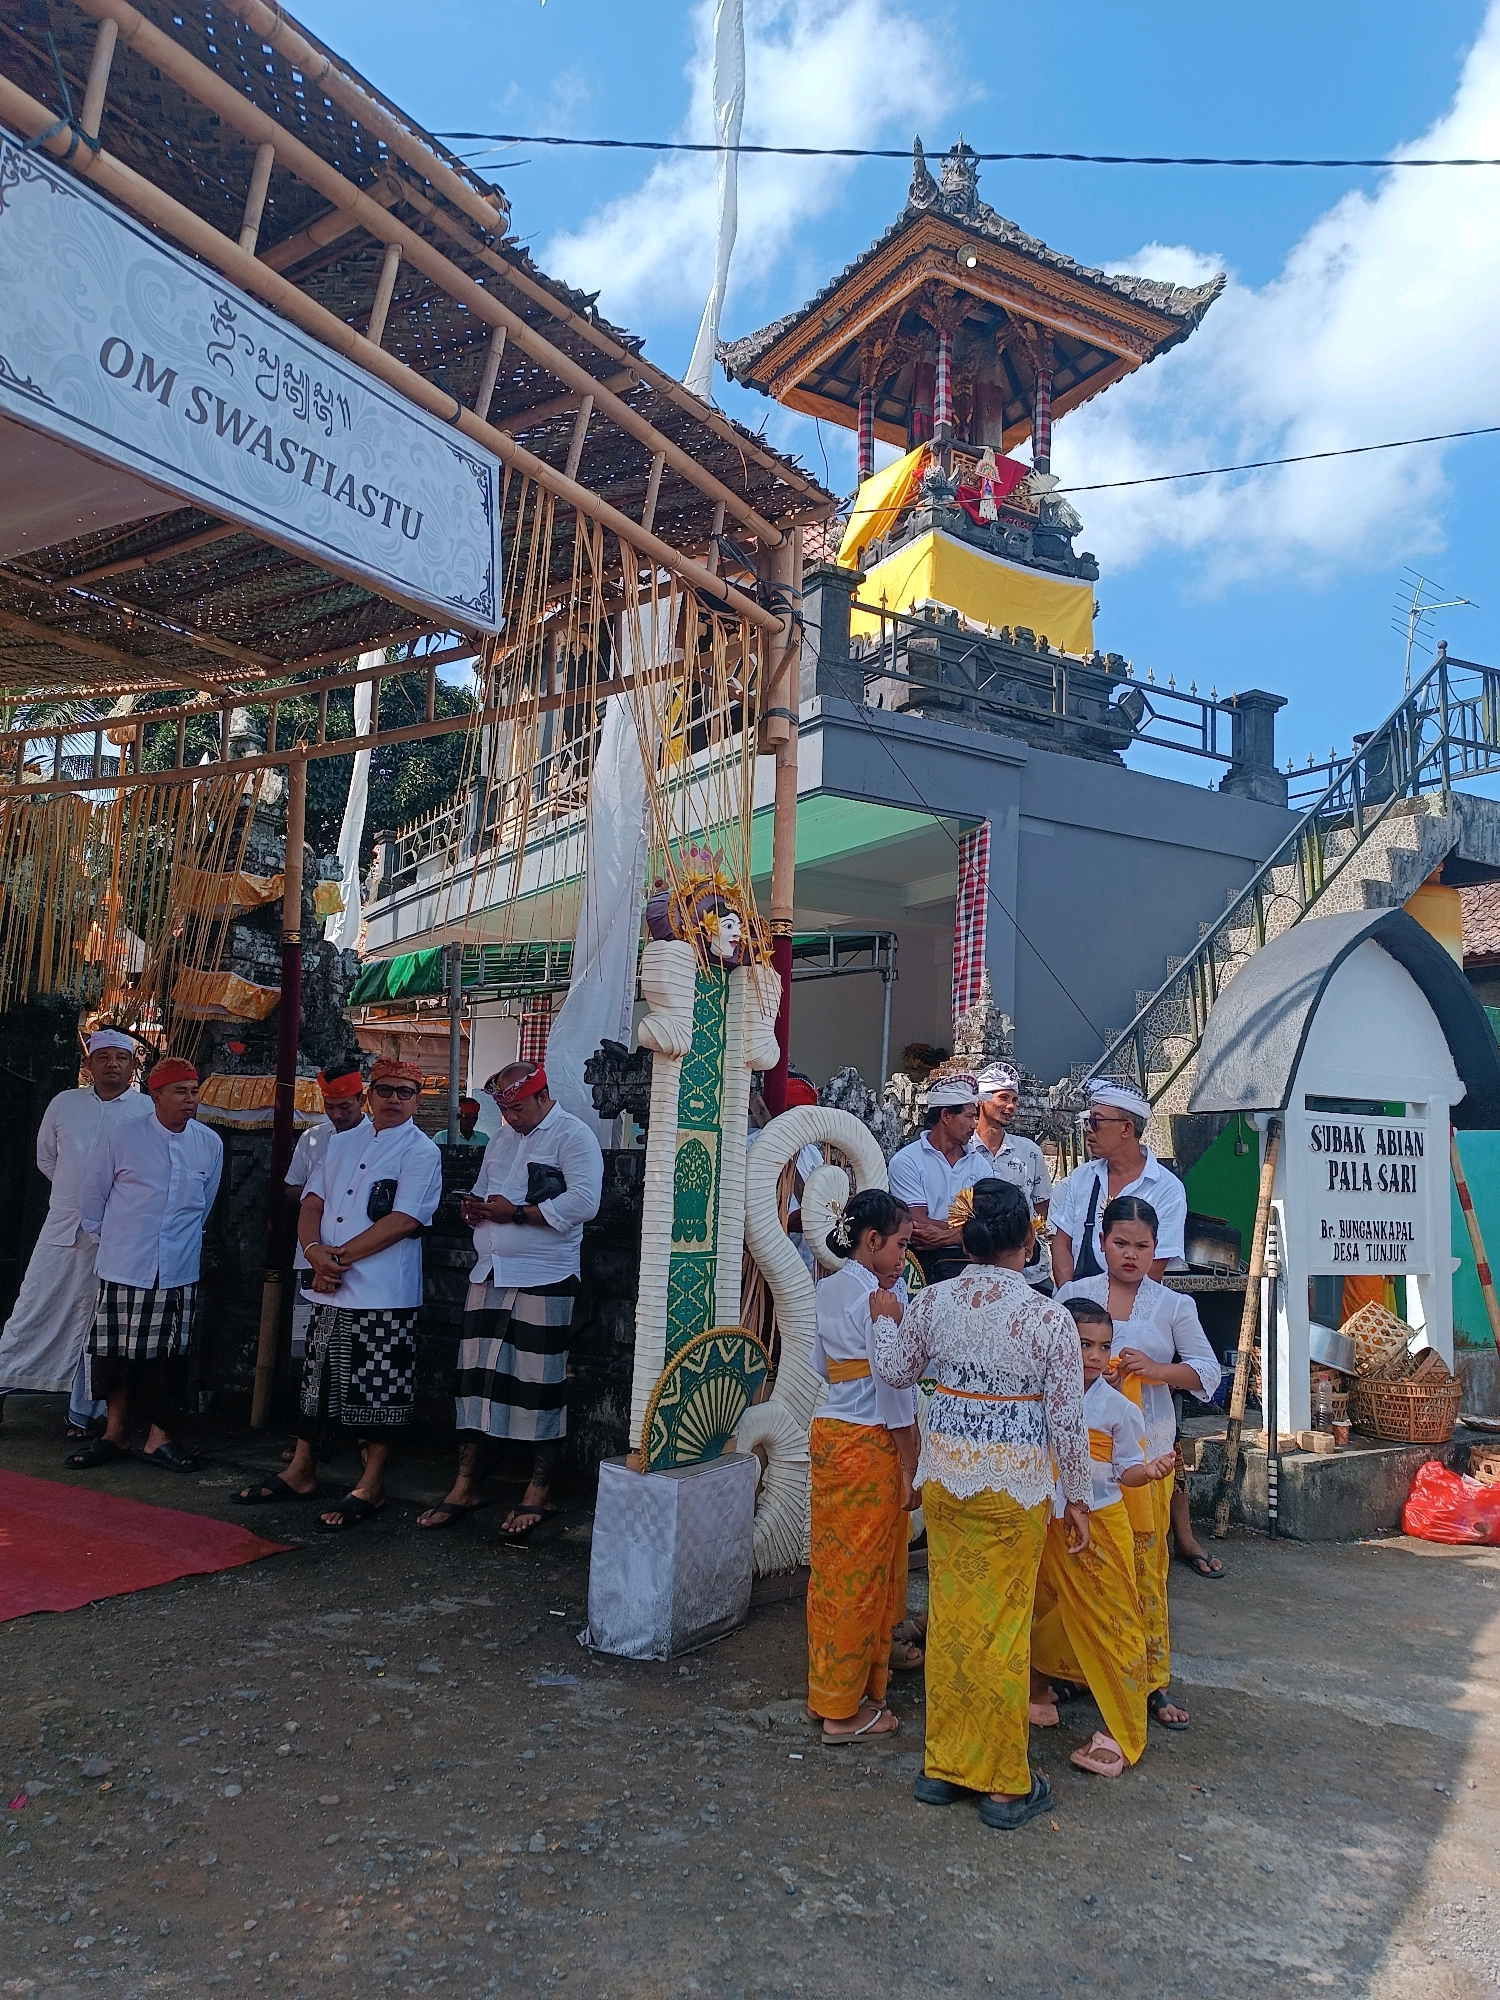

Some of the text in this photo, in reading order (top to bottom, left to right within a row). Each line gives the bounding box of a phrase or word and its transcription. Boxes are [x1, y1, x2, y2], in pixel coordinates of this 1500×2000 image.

[99, 336, 425, 542] OM SWASTIASTU
[1309, 1124, 1424, 1156] SUBAK ABIAN
[1328, 1159, 1417, 1192] PALA SARI
[1320, 1219, 1336, 1239] Br.
[1333, 1243, 1408, 1262] DESA TUNJUK
